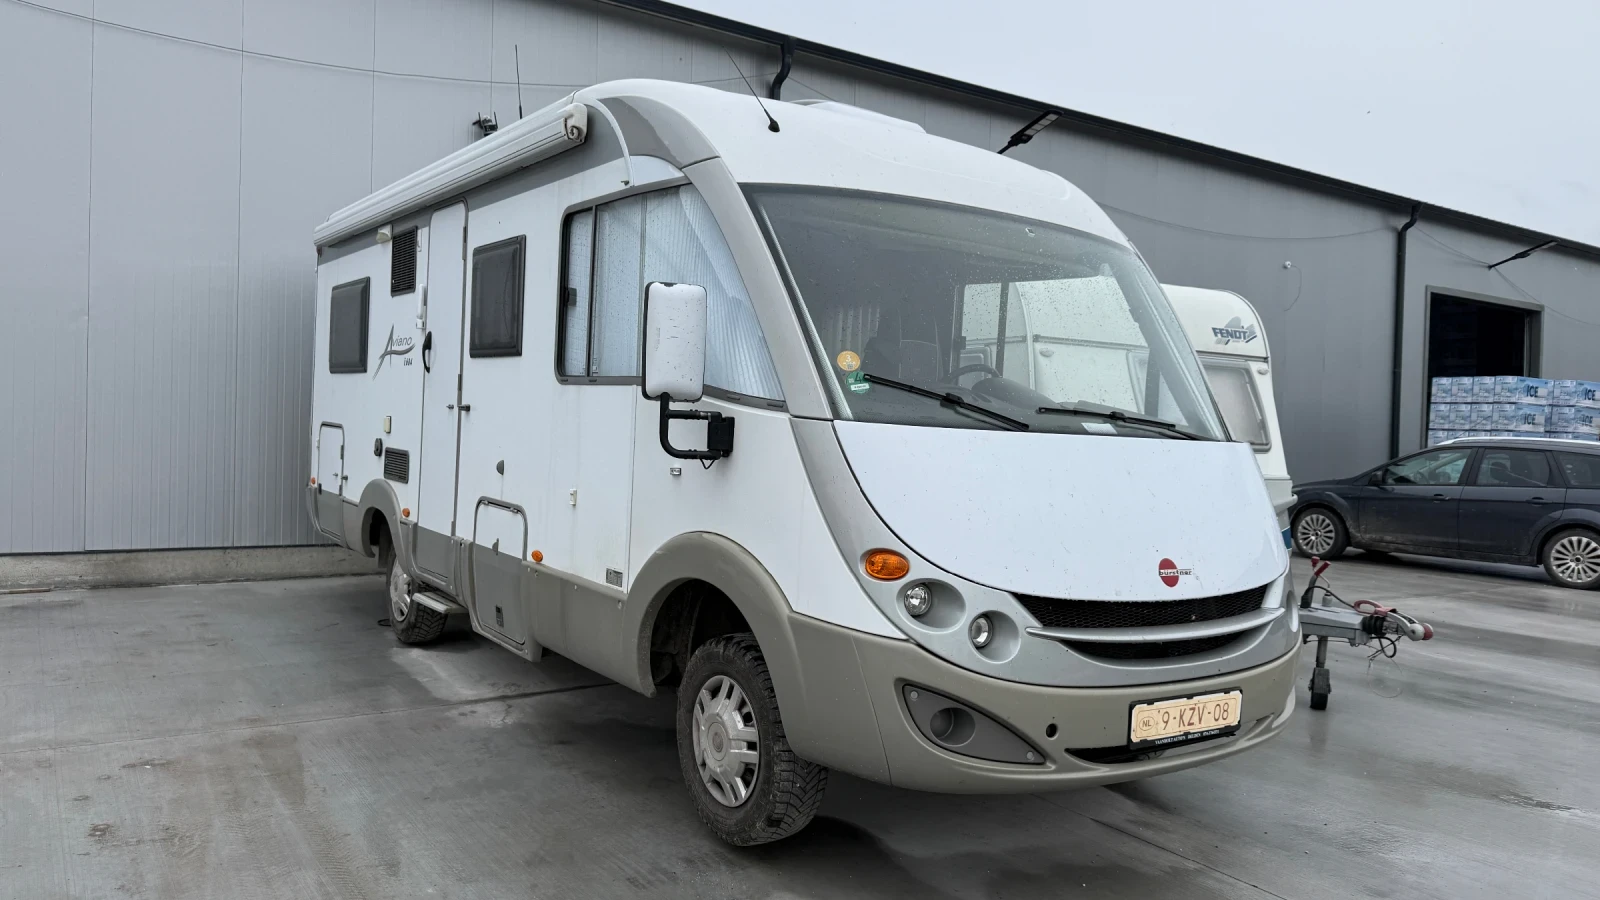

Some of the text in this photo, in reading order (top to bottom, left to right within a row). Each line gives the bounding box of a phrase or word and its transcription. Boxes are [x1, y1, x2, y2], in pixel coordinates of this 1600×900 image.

[1211, 327, 1248, 341] FENDT
[1526, 384, 1539, 398] ICE
[1584, 388, 1597, 401] ICE
[1523, 413, 1537, 425] ICE
[1142, 719, 1152, 728] NL
